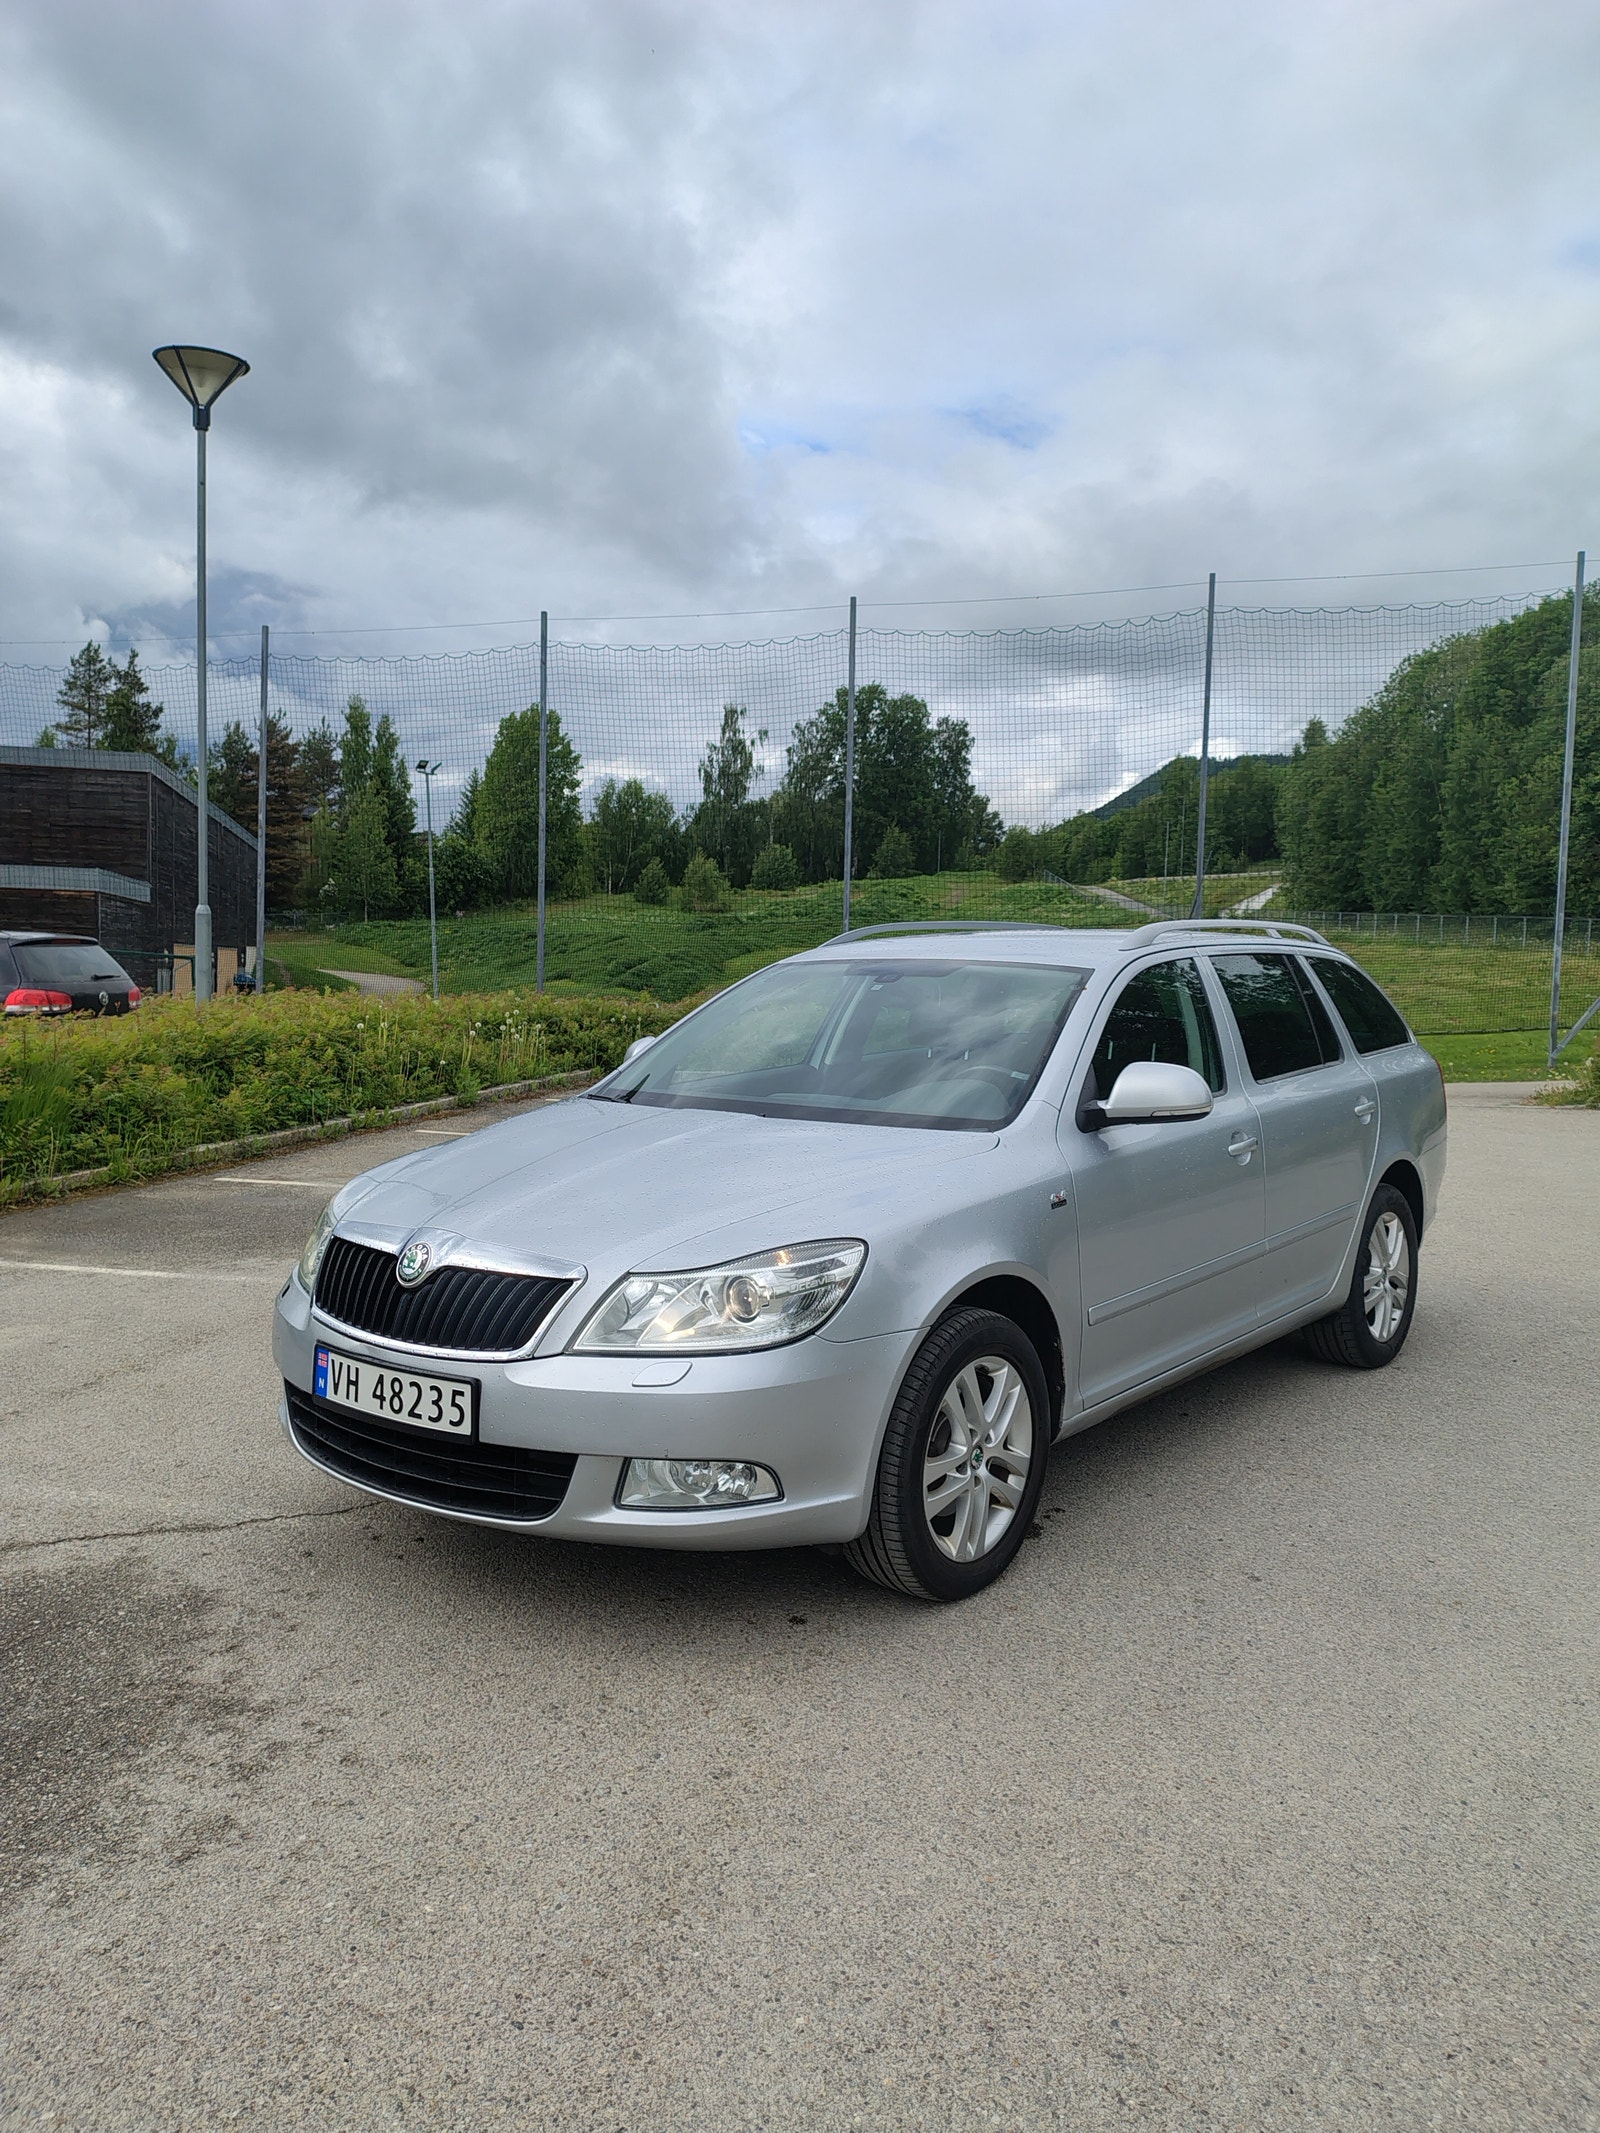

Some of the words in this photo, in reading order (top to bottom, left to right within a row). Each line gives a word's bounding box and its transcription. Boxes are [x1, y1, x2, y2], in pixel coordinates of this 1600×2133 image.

[318, 1377, 325, 1389] N
[331, 1358, 359, 1403] VH
[372, 1373, 465, 1427] 48235
